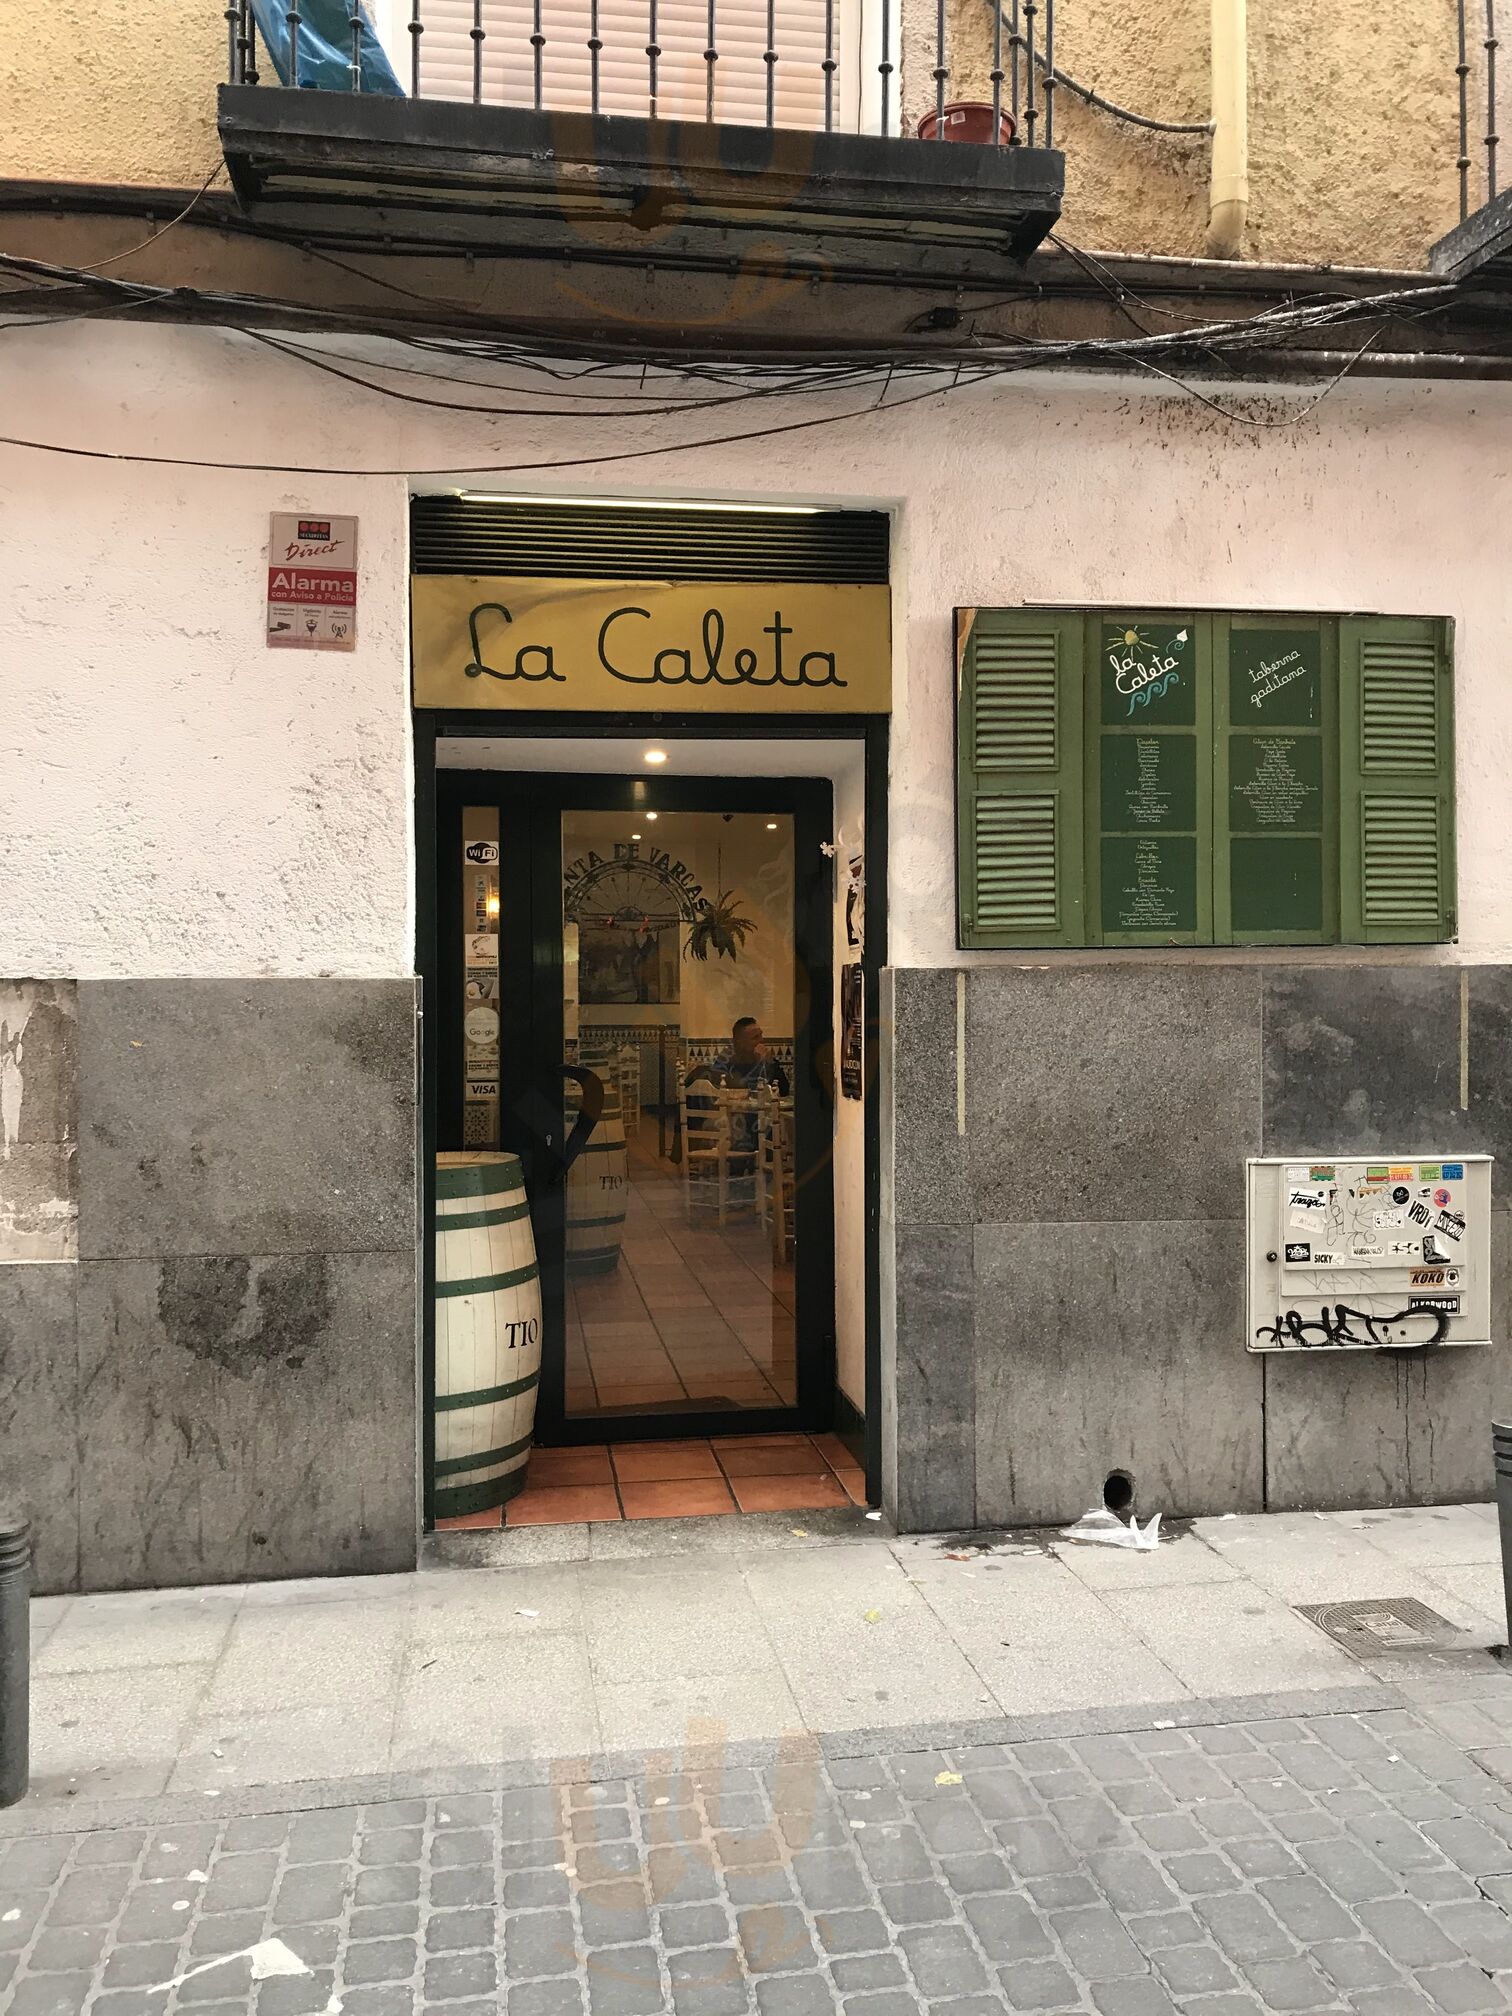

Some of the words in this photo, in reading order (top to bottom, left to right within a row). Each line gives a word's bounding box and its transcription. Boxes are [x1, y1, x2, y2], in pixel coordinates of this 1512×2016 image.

[285, 540, 345, 561] Direct
[272, 573, 354, 593] Alarma
[289, 591, 314, 600] Aviso
[464, 602, 567, 682] La
[598, 606, 848, 687] Caleta
[1115, 654, 1179, 694] Caleta
[1248, 650, 1301, 684] taberna
[1250, 666, 1307, 708] gaditana
[564, 850, 605, 897] NTA
[613, 843, 640, 860] DE
[472, 1085, 496, 1094] VISA
[599, 1175, 622, 1191] TIO
[1314, 1253, 1334, 1264] SICKY
[1411, 1272, 1445, 1284] KOKO
[504, 1317, 538, 1349] TIO
